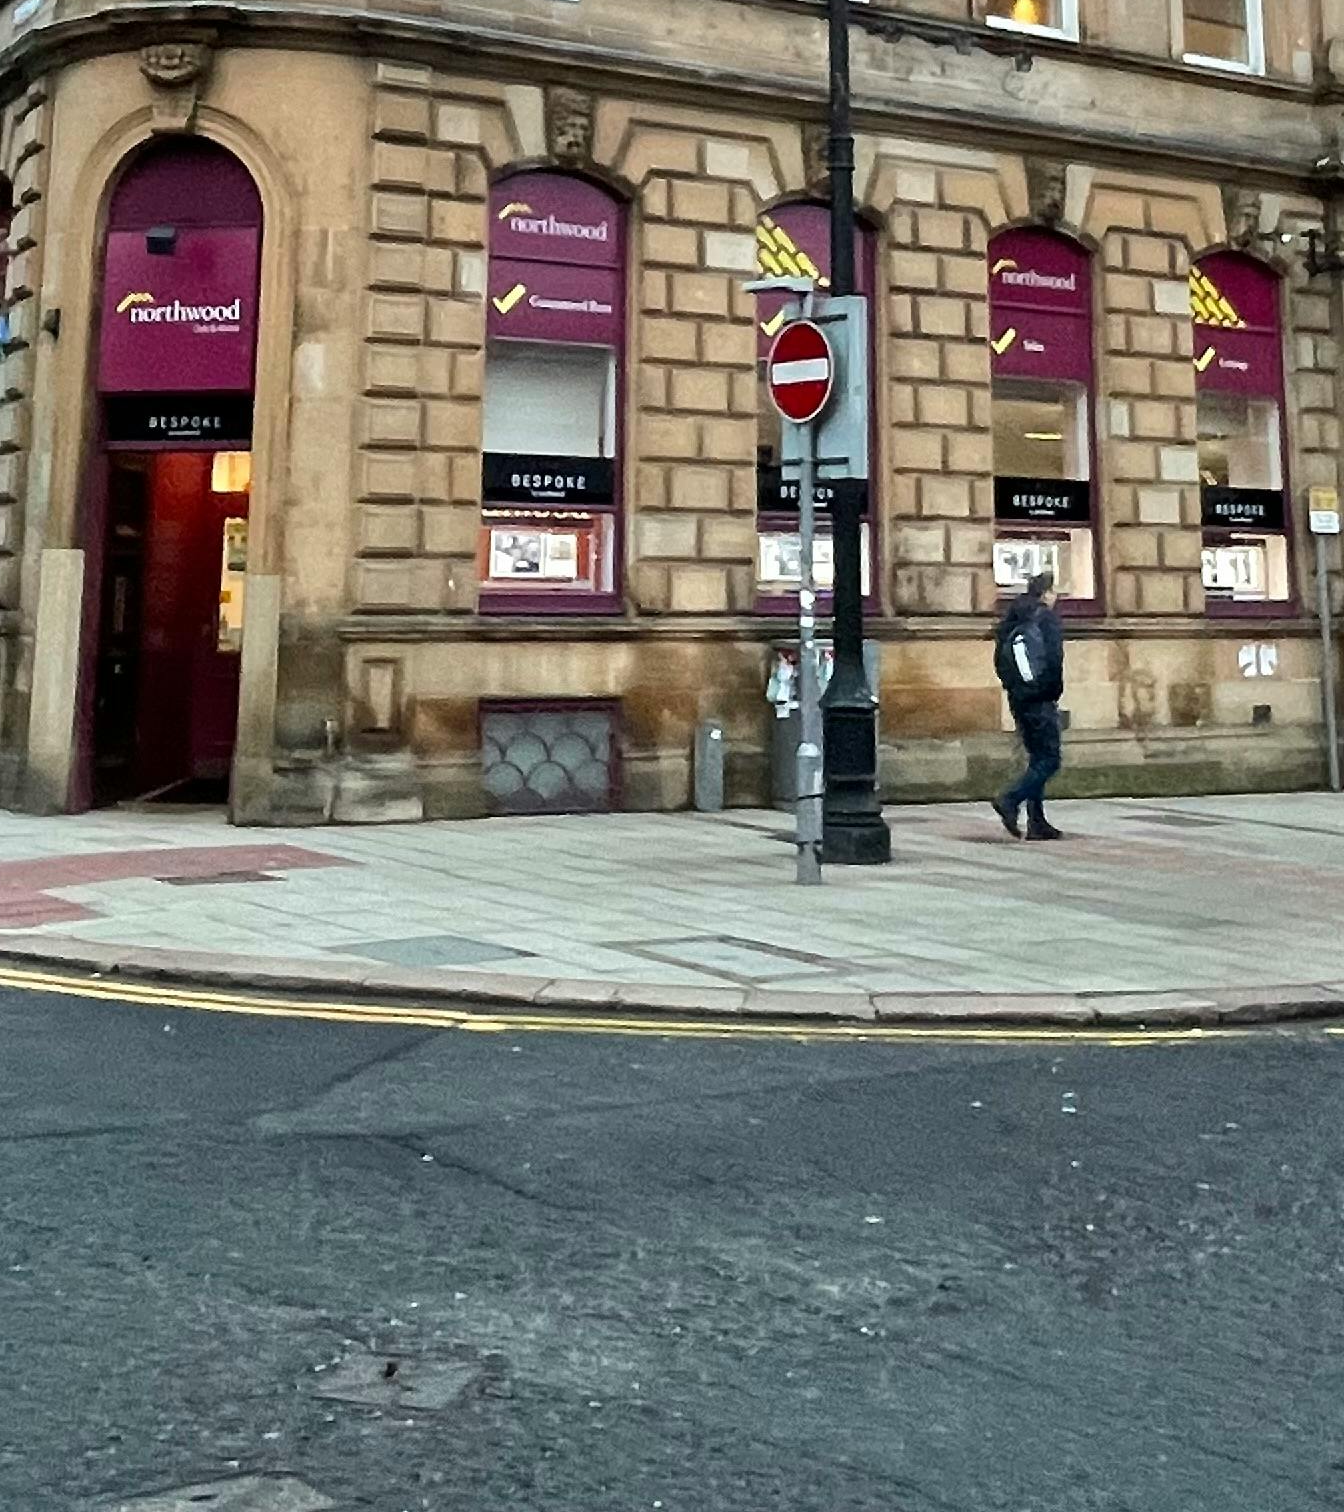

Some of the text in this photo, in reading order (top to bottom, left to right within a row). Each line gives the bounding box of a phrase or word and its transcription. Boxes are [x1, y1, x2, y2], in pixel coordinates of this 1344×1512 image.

[511, 214, 608, 242] northwood
[130, 299, 241, 322] northwood
[148, 416, 221, 429] BESPOKE
[511, 473, 586, 489] BESPOKE
[1012, 494, 1070, 508] BESPOKE
[1215, 503, 1264, 517] BESPOKE
